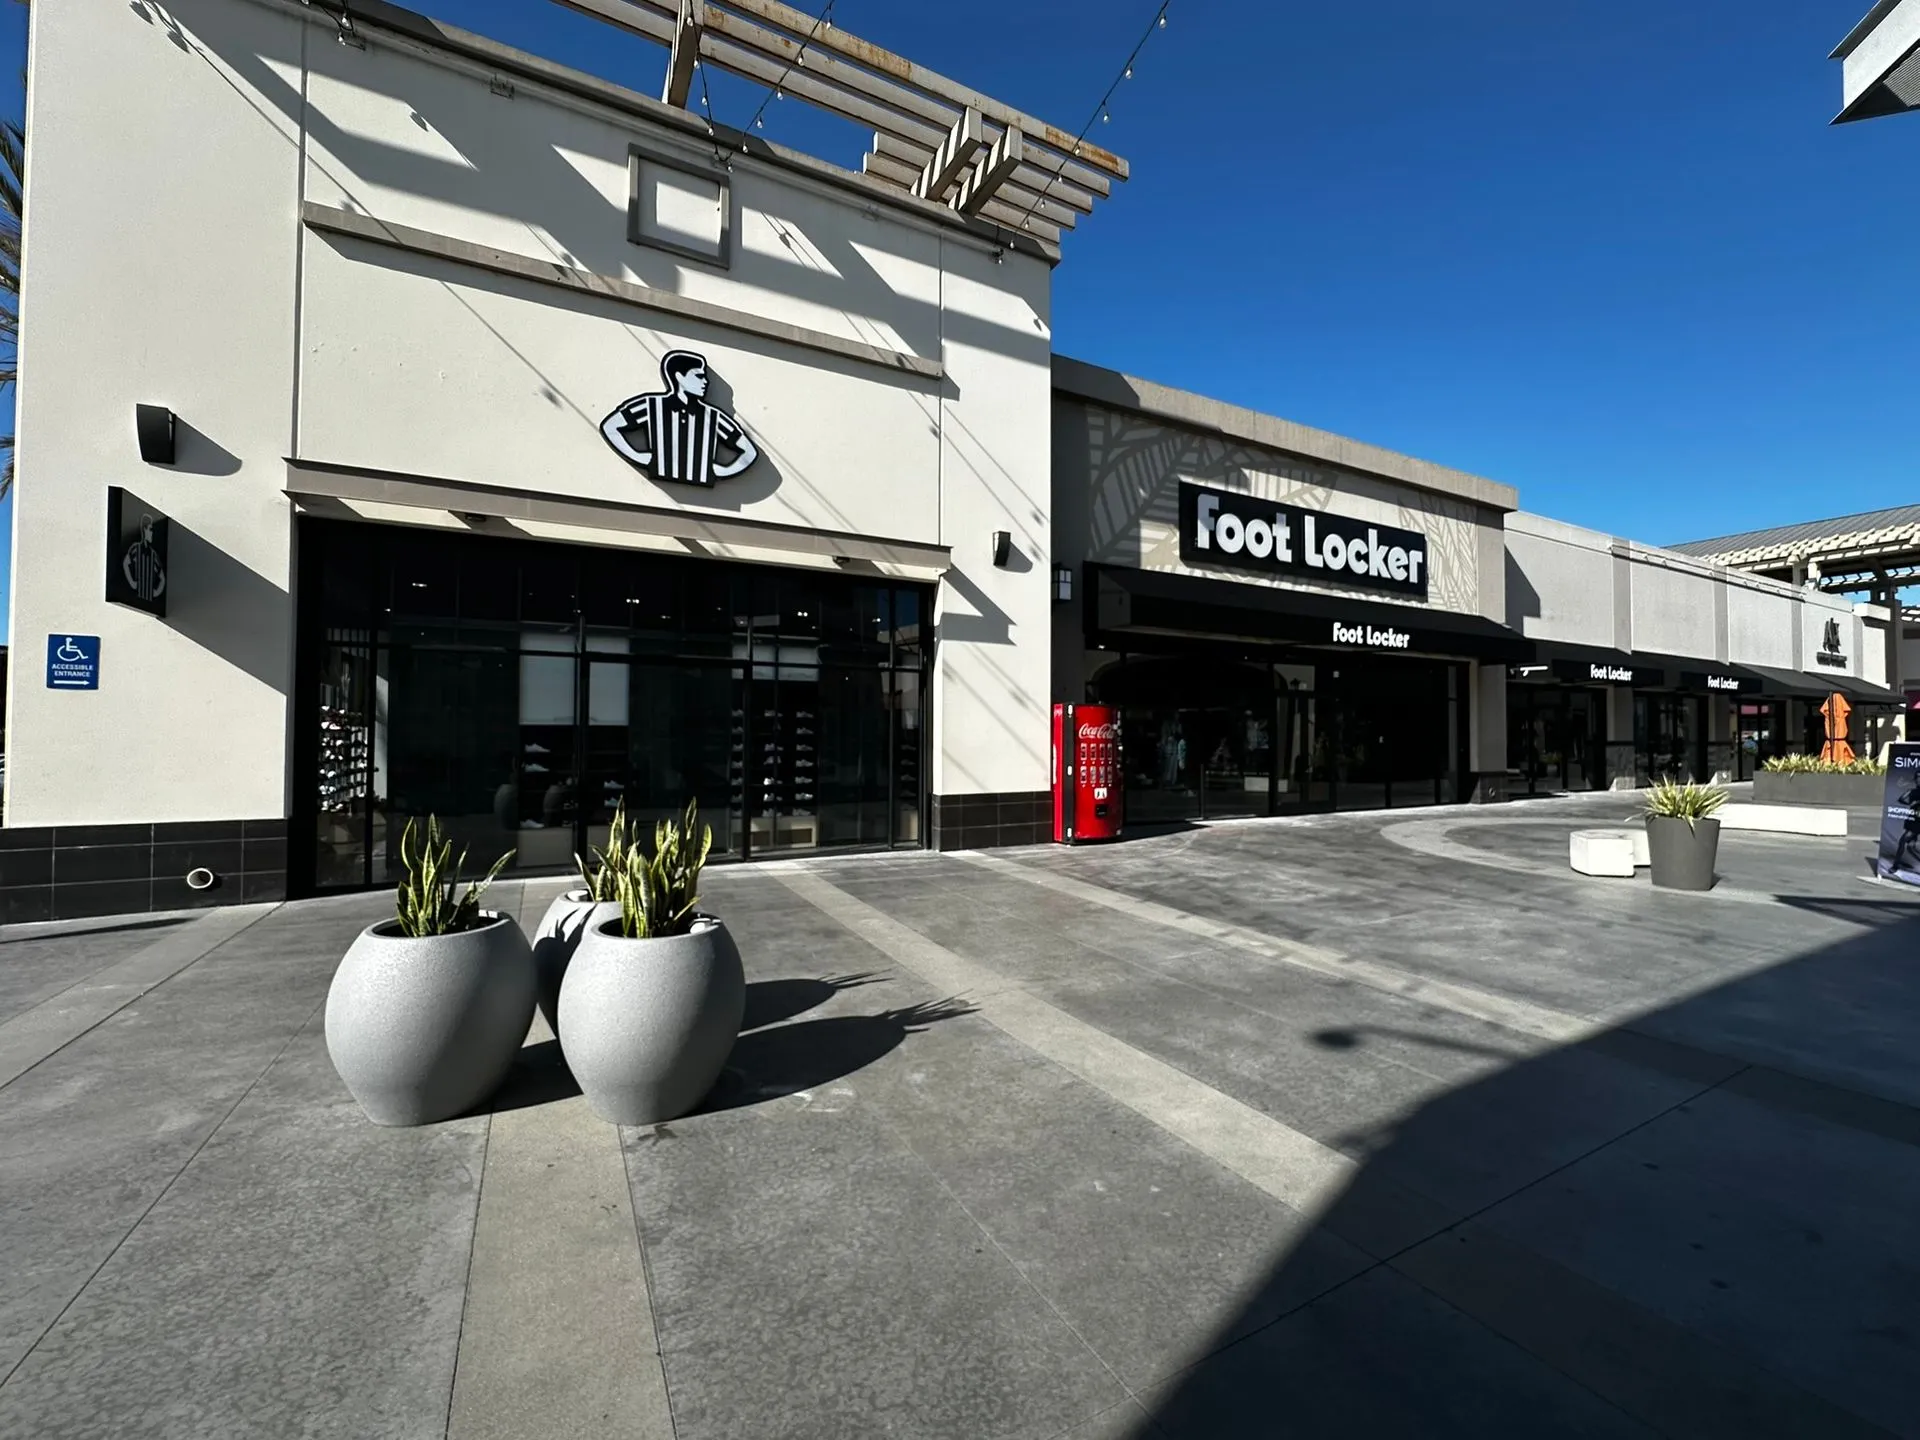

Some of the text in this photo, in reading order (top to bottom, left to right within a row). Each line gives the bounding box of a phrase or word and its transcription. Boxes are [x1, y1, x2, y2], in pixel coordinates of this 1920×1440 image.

[1197, 493, 1423, 584] Foot Locker
[1333, 622, 1410, 648] Foot Locker
[1590, 664, 1632, 681] Foot Locker
[1707, 675, 1739, 690] Foot Locker
[1895, 756, 1920, 768] SIM
